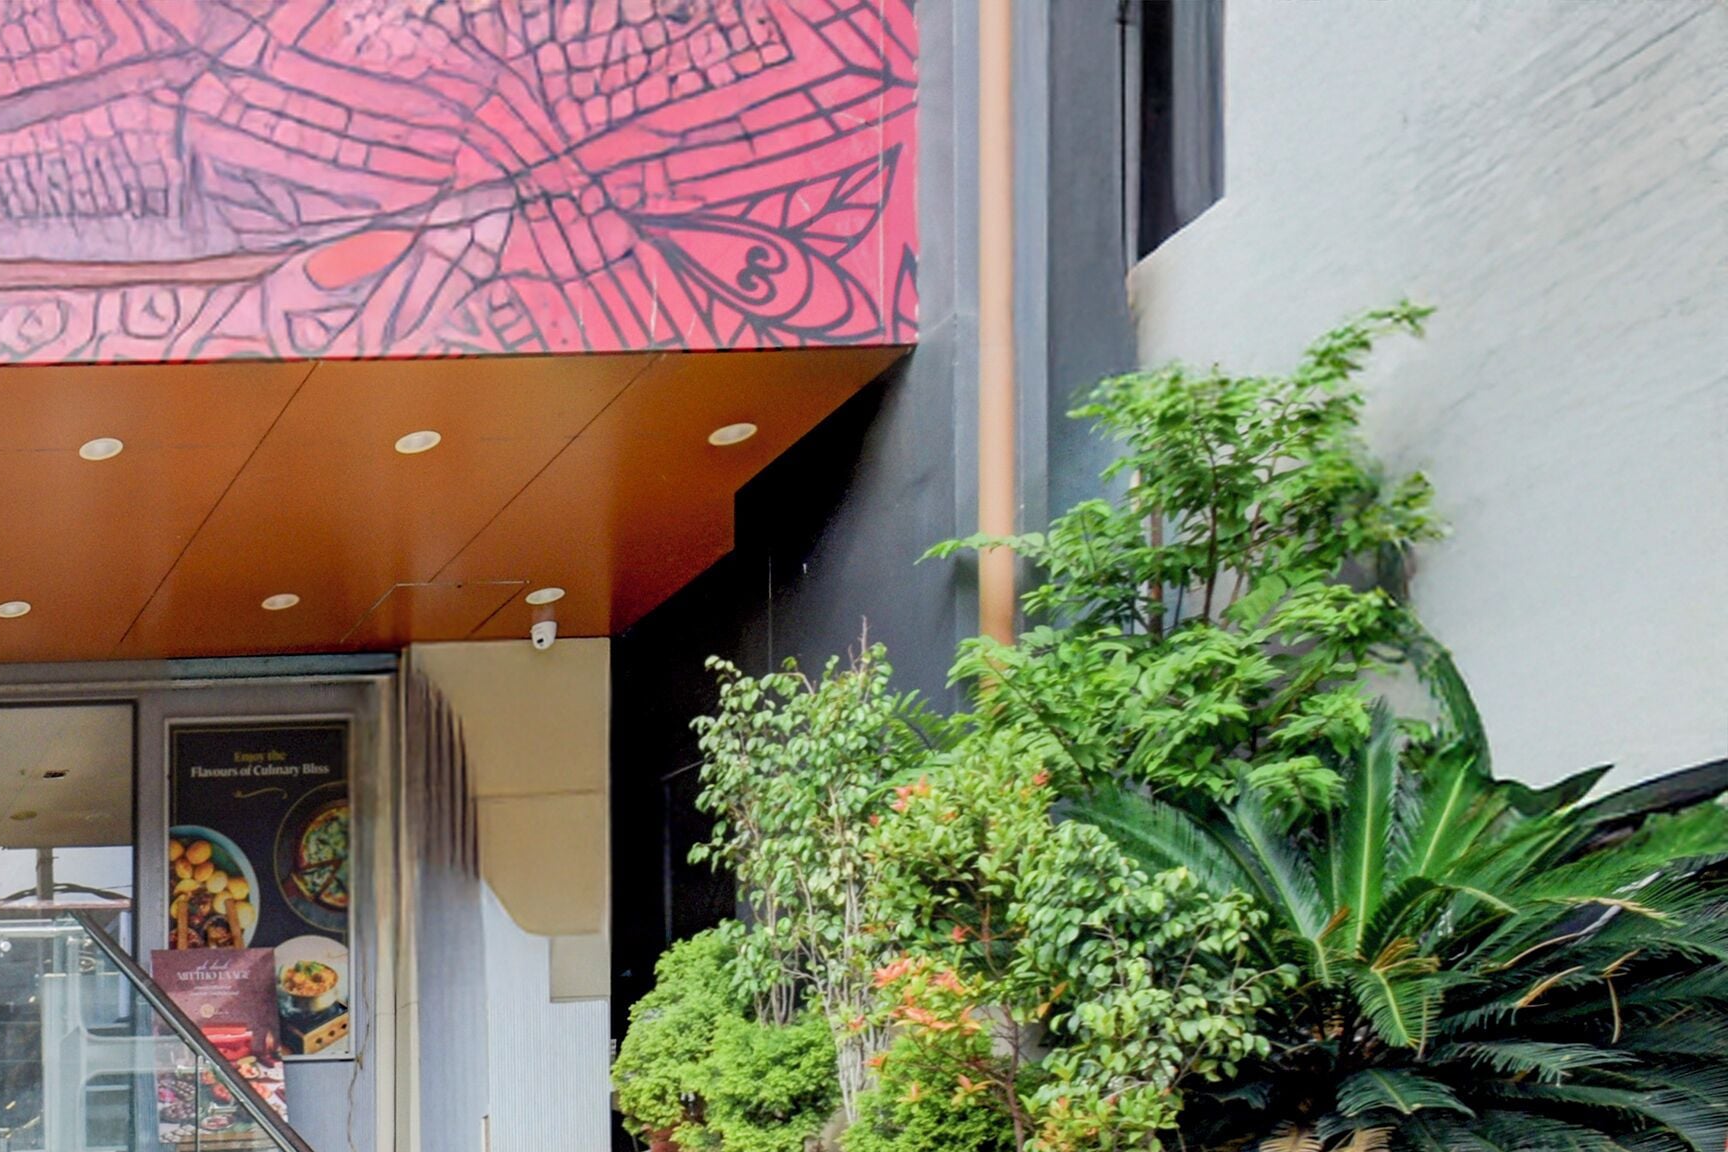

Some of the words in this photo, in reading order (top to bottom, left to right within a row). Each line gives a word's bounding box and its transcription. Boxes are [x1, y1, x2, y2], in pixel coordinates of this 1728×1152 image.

[267, 749, 287, 761] the
[190, 766, 238, 778] Flavours
[240, 764, 252, 776] of
[253, 764, 300, 777] Culinary
[302, 763, 330, 775] Bliss
